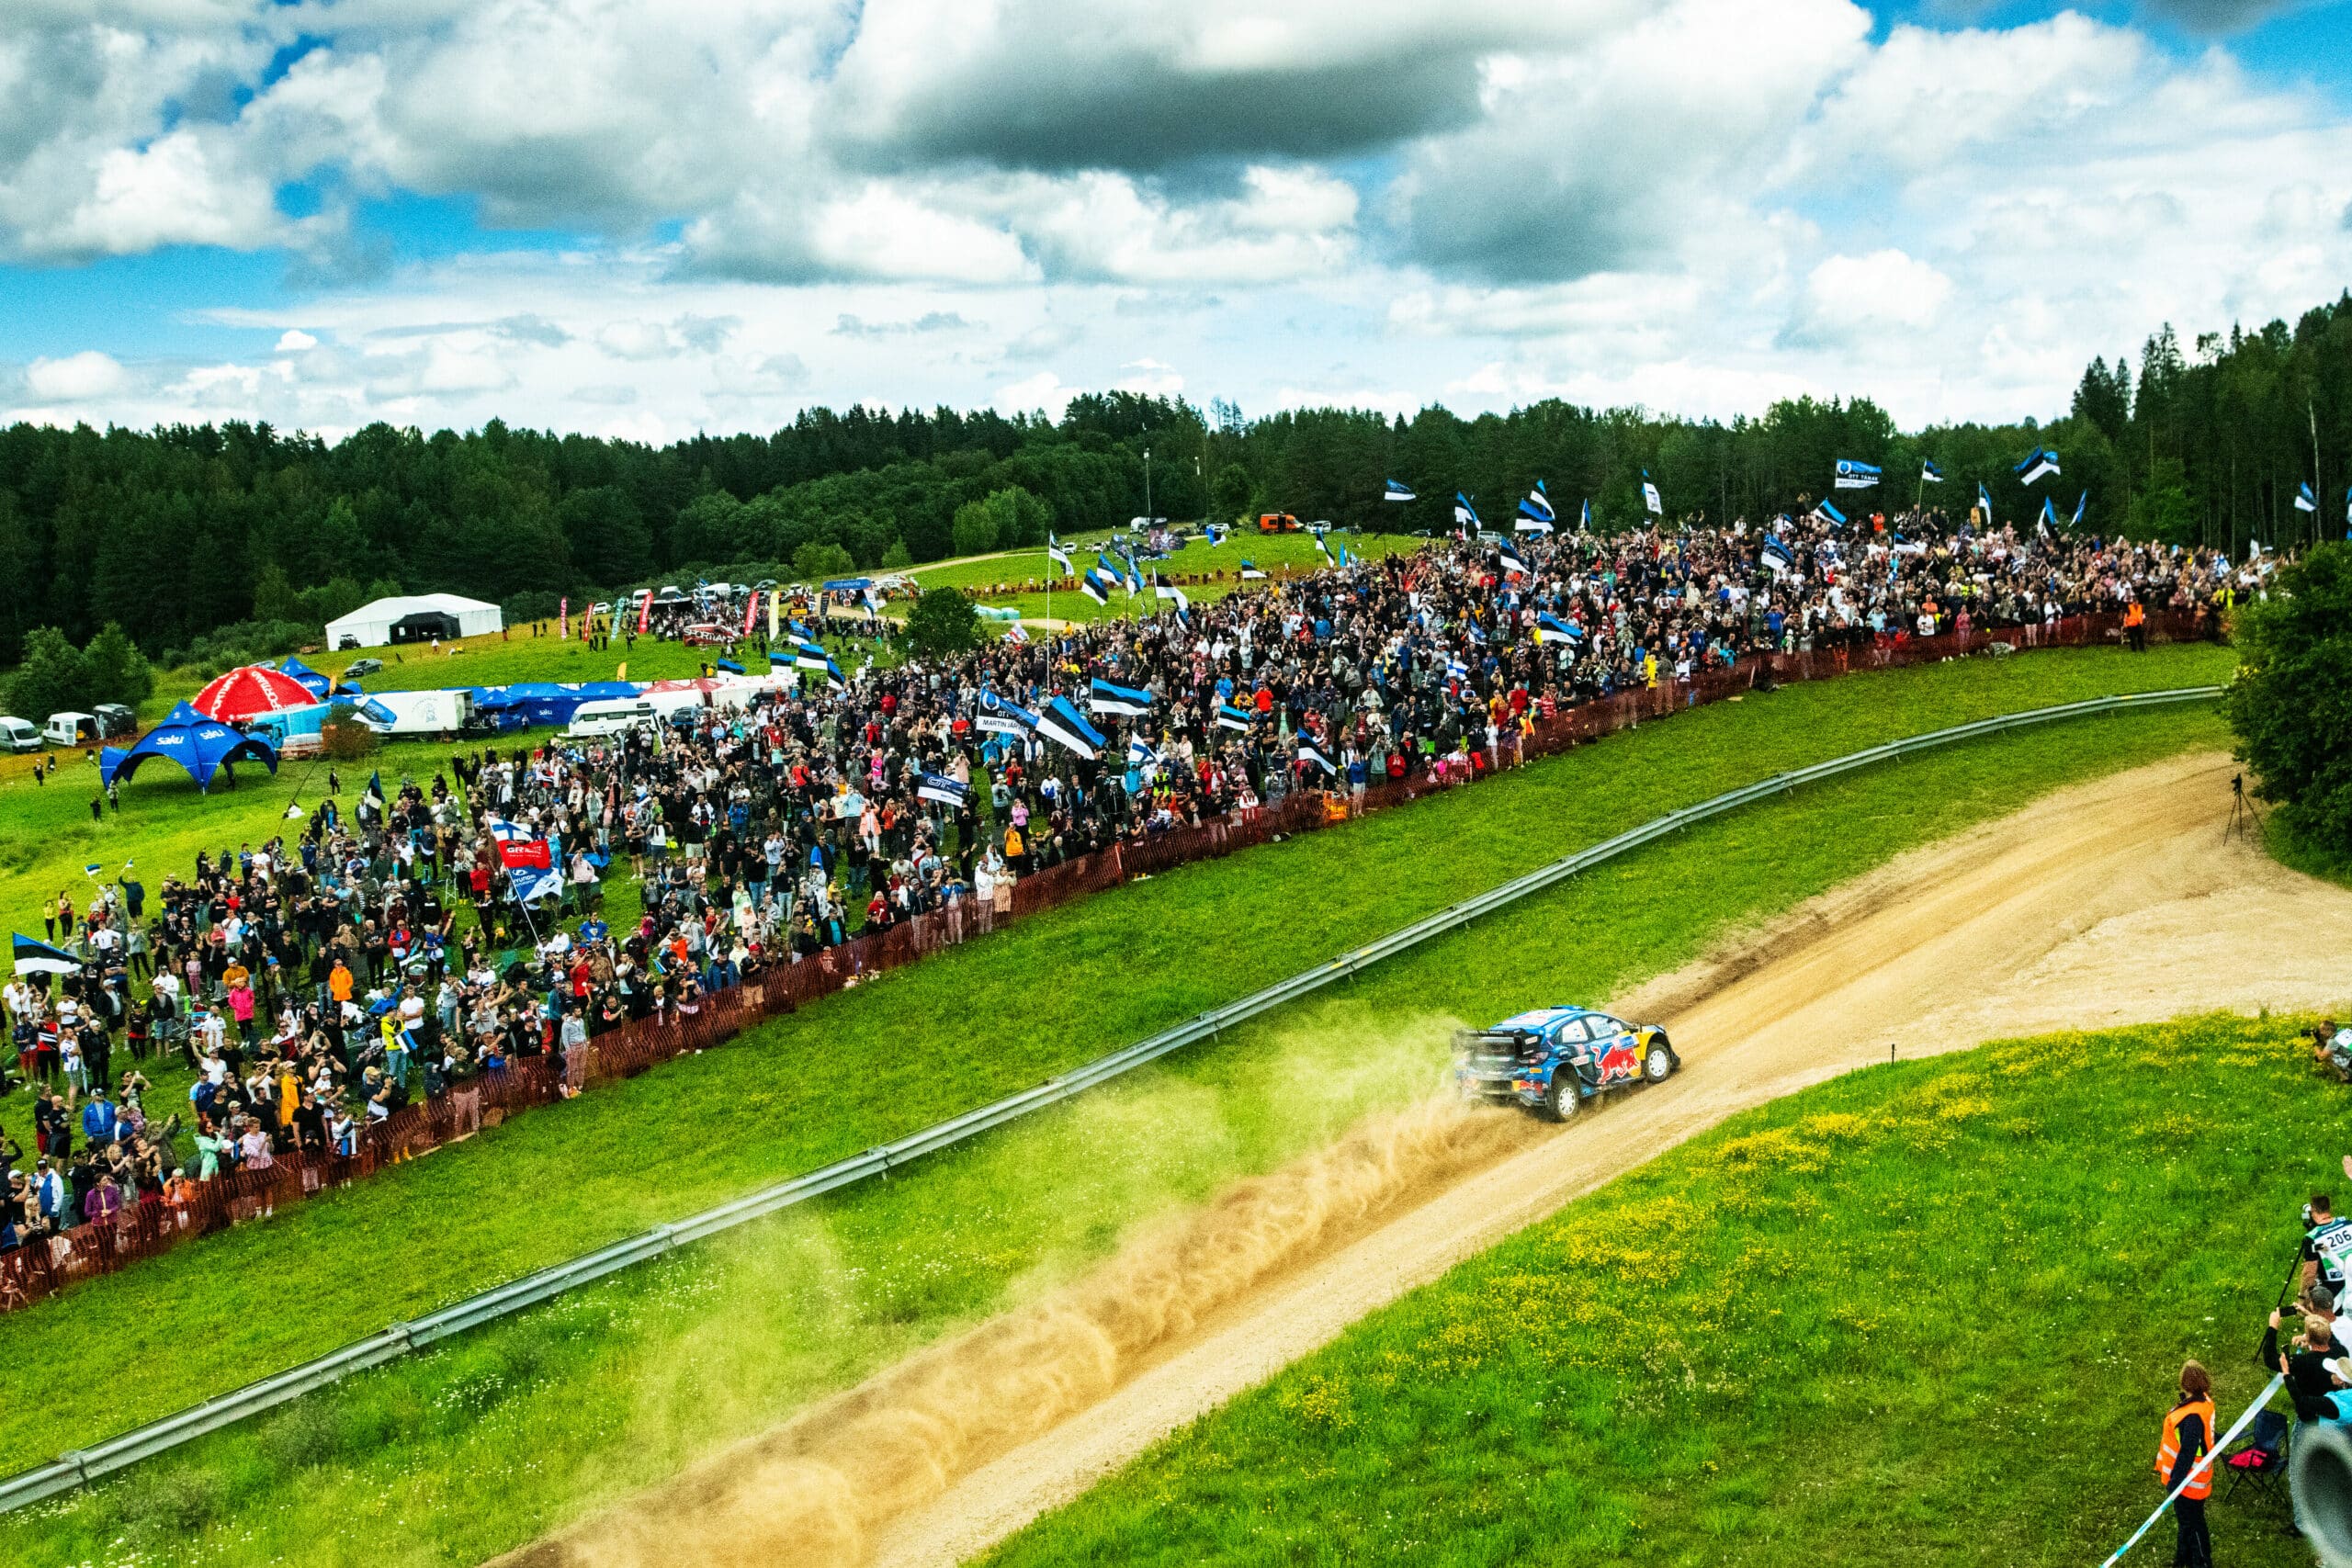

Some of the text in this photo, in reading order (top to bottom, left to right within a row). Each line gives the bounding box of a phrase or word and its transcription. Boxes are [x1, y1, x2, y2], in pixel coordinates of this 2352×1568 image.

[684, 628, 736, 643] SPORTLAND
[210, 673, 240, 721] SPORTLAND
[252, 671, 284, 711] SPORTLAND
[983, 719, 1007, 728] MARTIN
[156, 734, 185, 745] saku
[199, 729, 226, 740] saku
[2326, 1230, 2352, 1247] 206
